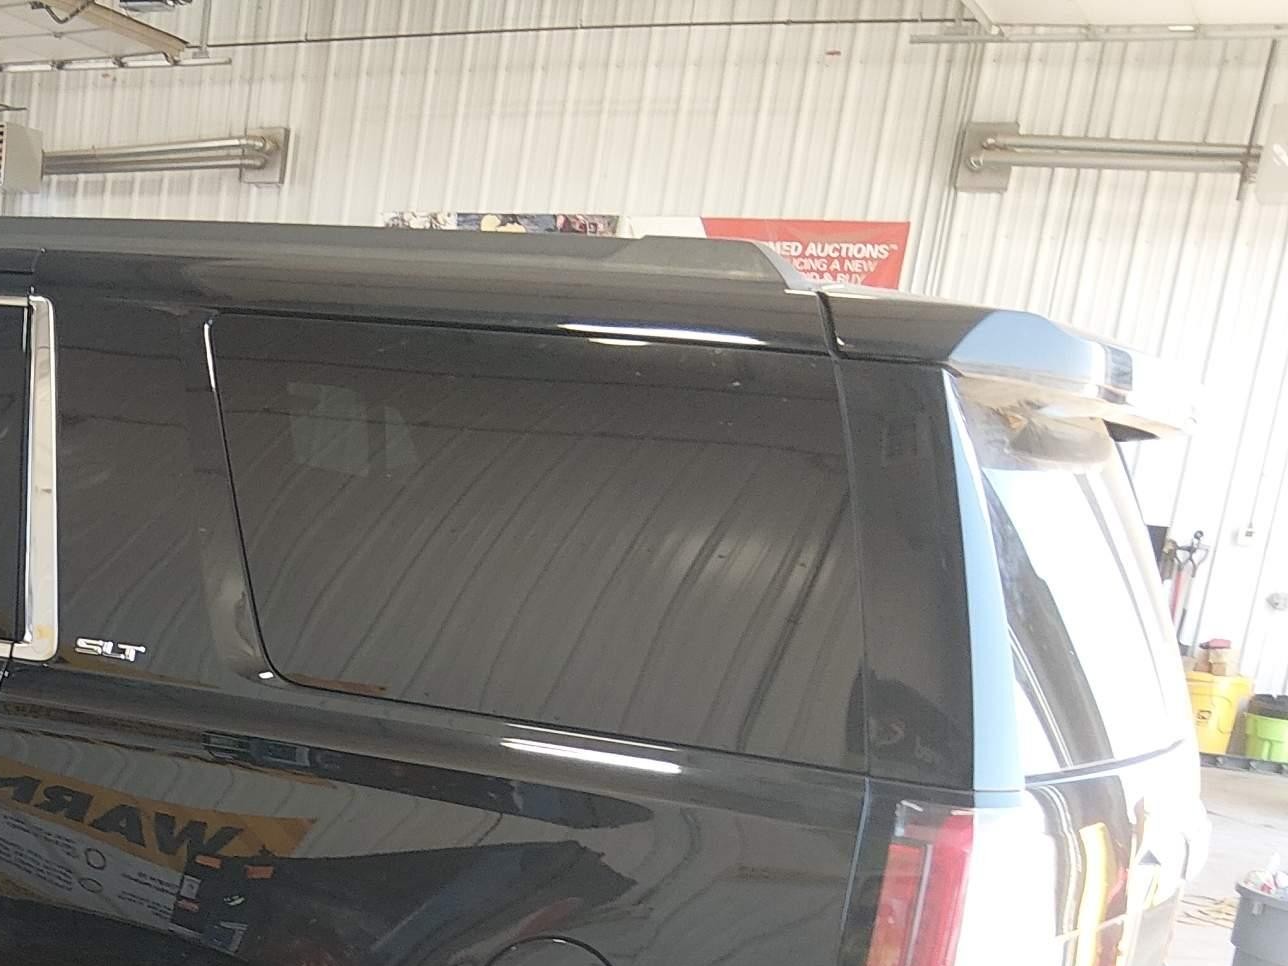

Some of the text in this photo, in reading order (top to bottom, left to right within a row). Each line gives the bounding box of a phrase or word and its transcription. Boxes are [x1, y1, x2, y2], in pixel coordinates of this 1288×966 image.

[829, 259, 841, 272] A
[844, 259, 879, 273] NEW
[74, 638, 146, 662] SLT
